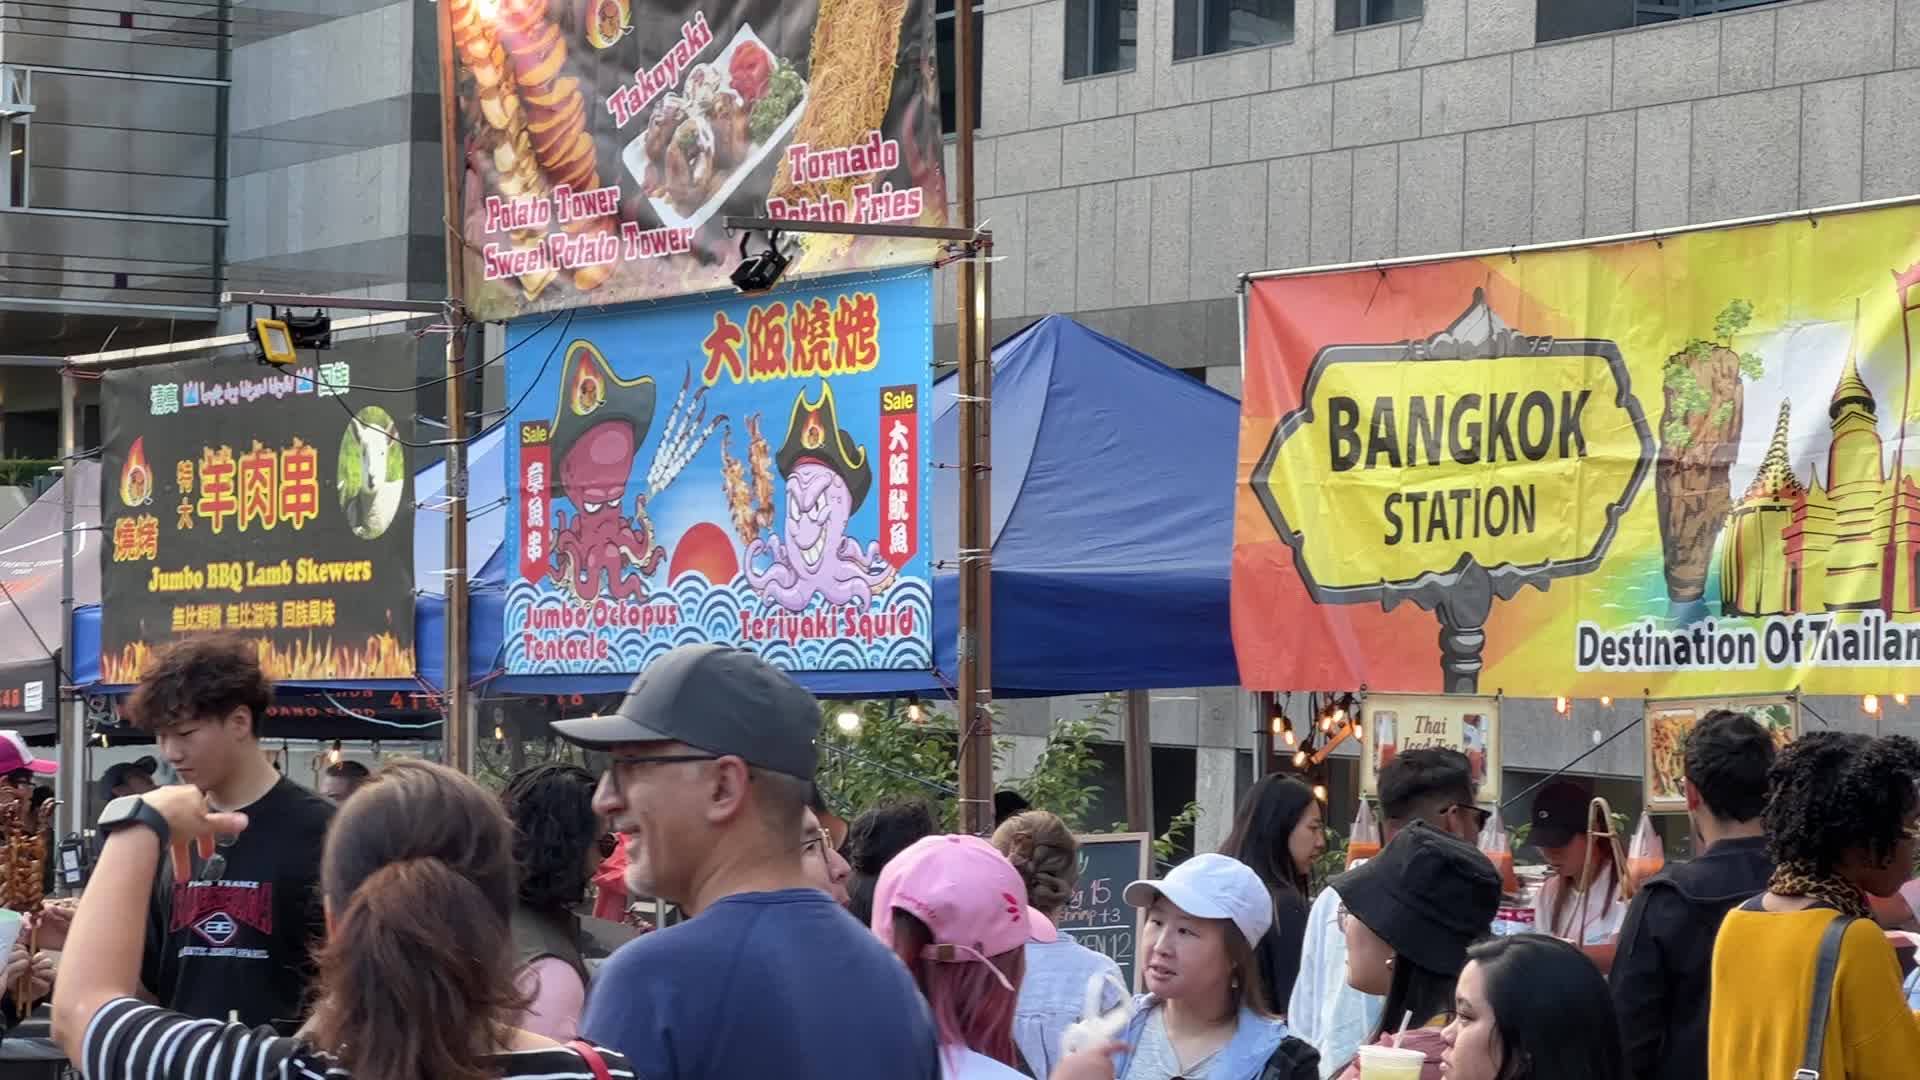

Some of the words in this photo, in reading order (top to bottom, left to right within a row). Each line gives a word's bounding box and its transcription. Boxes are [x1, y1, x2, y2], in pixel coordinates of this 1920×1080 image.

[607, 11, 713, 128] Takoyaki
[788, 130, 899, 184] Tornado
[485, 196, 550, 233] Potato
[554, 184, 620, 222] Tower
[852, 182, 923, 223] Fries
[483, 242, 550, 280] Sweet
[549, 231, 619, 270] Potato
[621, 222, 694, 260] Tower
[703, 291, 880, 385] 大阪燒烤
[883, 391, 914, 410] Sale
[522, 426, 547, 443] Sale
[1327, 388, 1592, 472] BANGKOK
[197, 440, 320, 534] 羊肉串
[1384, 483, 1537, 546] STATION
[148, 565, 204, 592] Jumbo
[206, 562, 243, 593] BBQ
[246, 560, 293, 587] Lamb
[295, 557, 372, 584] Skewers
[523, 602, 585, 631] Jumbo
[591, 599, 678, 634] Octopus
[738, 607, 837, 645] Teriyaki
[843, 606, 914, 645] Squid
[523, 632, 608, 661] Tentacle
[1578, 621, 1756, 667] Destination
[1764, 617, 1804, 664] Of
[1415, 715, 1448, 735] Thai
[1090, 877, 1112, 905] 15
[1110, 931, 1133, 961] 12
